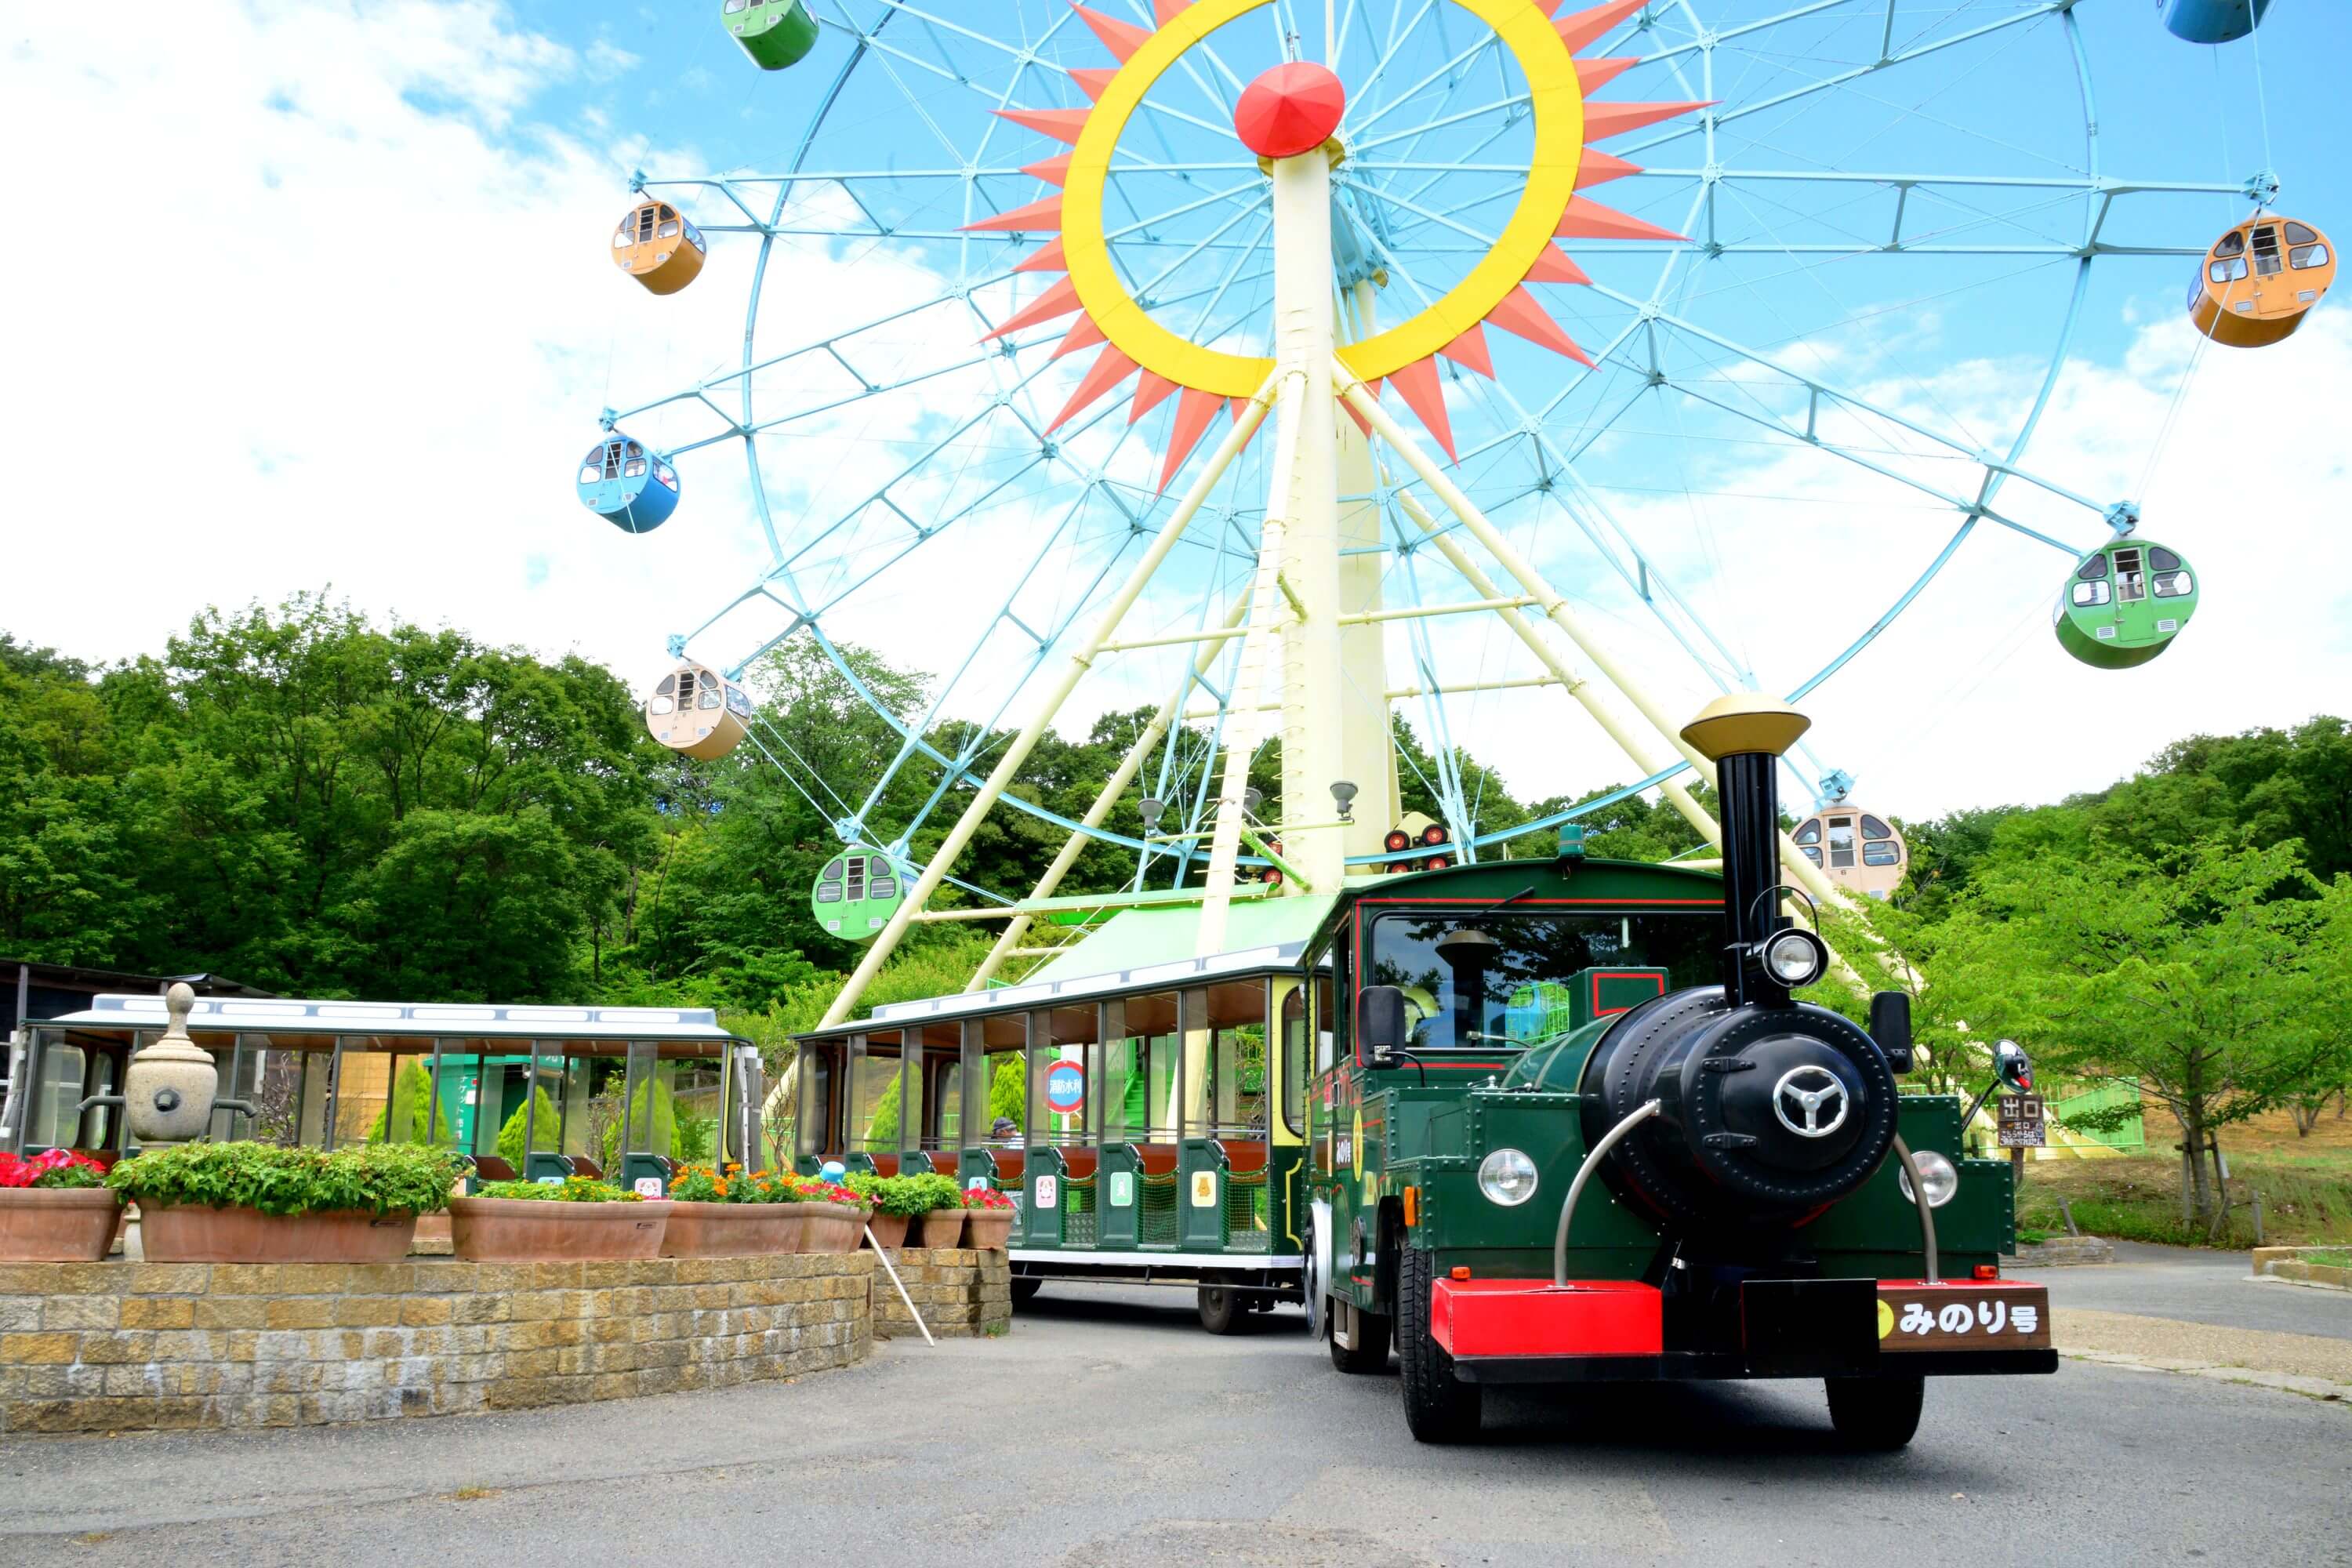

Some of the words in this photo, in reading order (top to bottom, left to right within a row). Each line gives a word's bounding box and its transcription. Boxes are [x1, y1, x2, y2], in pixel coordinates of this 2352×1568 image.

[1049, 1079, 1083, 1094] 消防水利
[2004, 1098, 2038, 1117] 出口
[1900, 1301, 2038, 1335] みのり号
